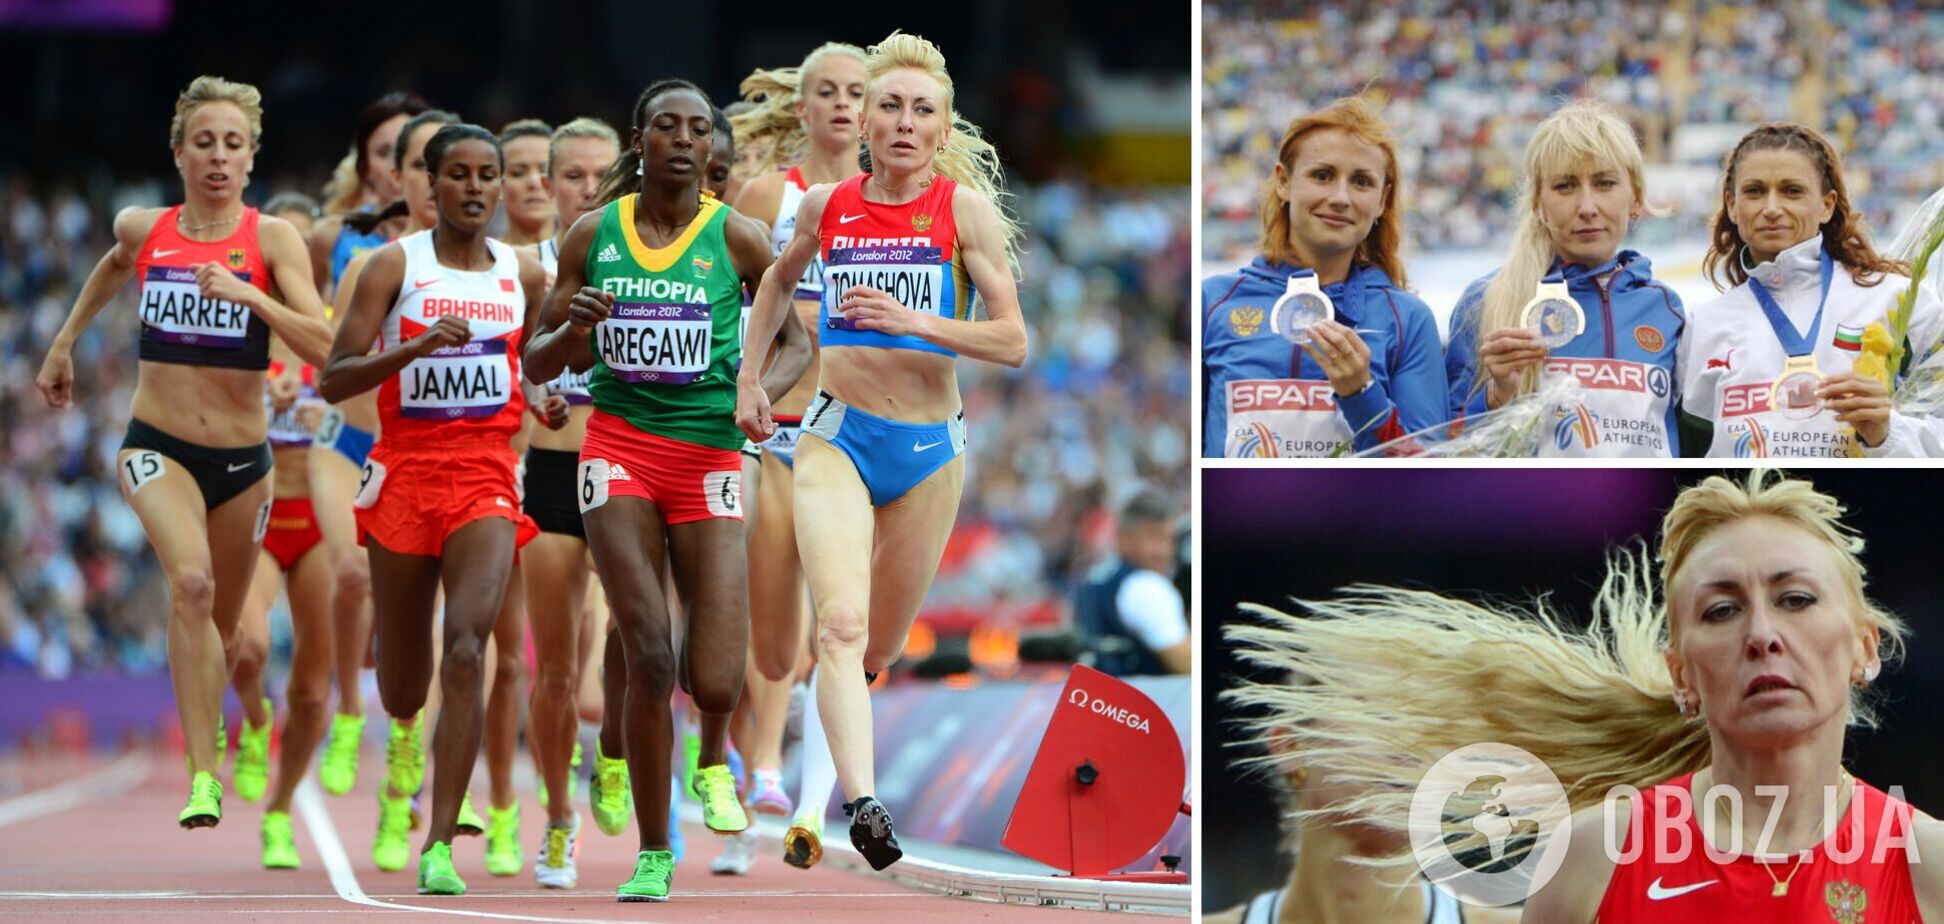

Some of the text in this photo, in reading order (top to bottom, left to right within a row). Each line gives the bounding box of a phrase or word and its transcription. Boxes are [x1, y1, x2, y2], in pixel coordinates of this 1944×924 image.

[852, 249, 913, 261] London 2012
[602, 277, 708, 304] ETHIOPIA
[144, 290, 245, 329] HARRER
[422, 298, 514, 324] BAHRAIN
[619, 305, 682, 317] London 2012
[600, 324, 707, 366] AREGAWI
[409, 364, 502, 400] JAMAL
[1543, 362, 1644, 387] SPAR
[810, 390, 834, 427] 7
[1233, 384, 1336, 408] SPAR
[1724, 387, 1770, 412] SP
[1603, 418, 1662, 435] EUROPEAN
[1772, 430, 1849, 446] EUROPEAN
[1772, 445, 1849, 459] ATHLETICS
[125, 452, 159, 487] 15
[356, 464, 372, 499] 9
[583, 465, 594, 505] 6
[722, 476, 735, 511] 6
[1090, 698, 1150, 735] OMEGA
